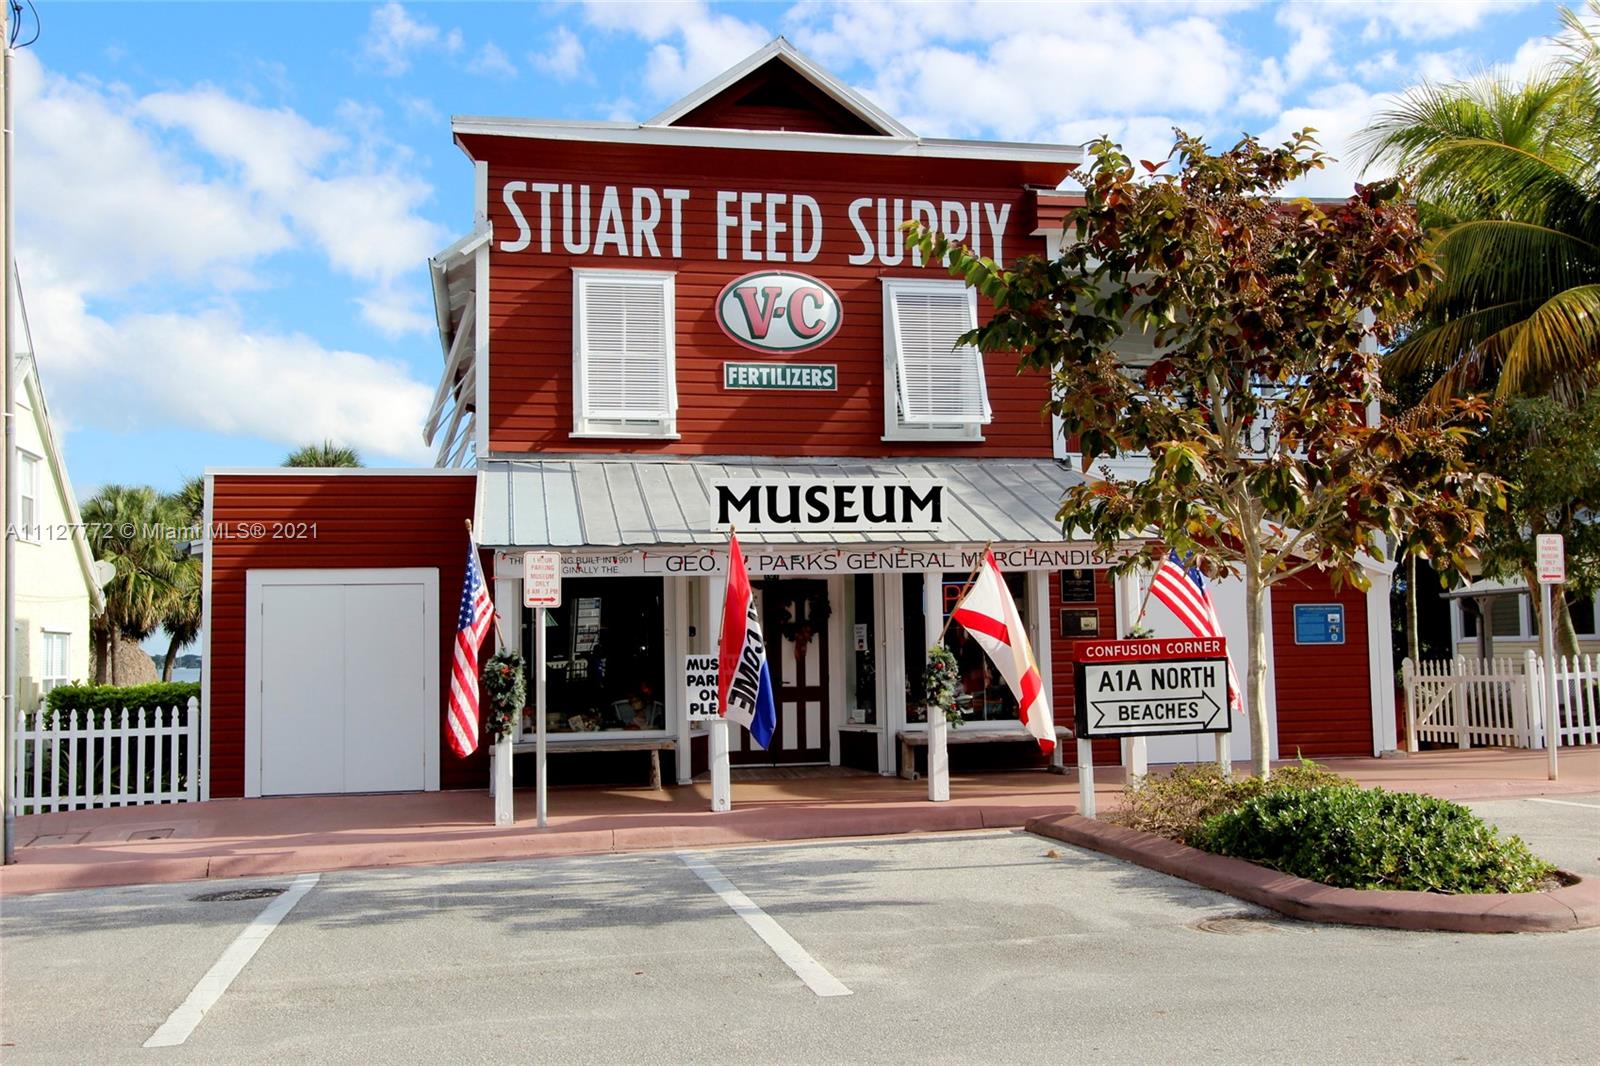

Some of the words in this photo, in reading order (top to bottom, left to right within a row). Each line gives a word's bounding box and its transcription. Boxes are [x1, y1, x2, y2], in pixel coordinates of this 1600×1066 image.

[500, 181, 690, 258] STUART
[717, 191, 823, 262] FEED
[733, 286, 827, 339] V-C
[728, 367, 833, 387] FERTILIZERS
[714, 485, 944, 524] MUSEUM
[562, 566, 599, 574] GINALLY
[601, 565, 619, 574] THE
[576, 556, 601, 564] BUILT
[602, 556, 612, 564] IN
[613, 556, 633, 564] 901
[665, 555, 721, 572] GEO.
[760, 554, 838, 571] PARKS
[847, 552, 955, 570] GENERAL
[961, 549, 1118, 568] MRCHANDISE
[1086, 643, 1161, 657] CONFUSION
[1166, 640, 1221, 654] CORNER
[686, 658, 720, 671] MUS
[1098, 669, 1142, 692] A1A
[1152, 666, 1215, 690] NORTH
[699, 689, 720, 701] ON
[690, 703, 720, 715] PLE
[1118, 702, 1199, 721] BEACHES
